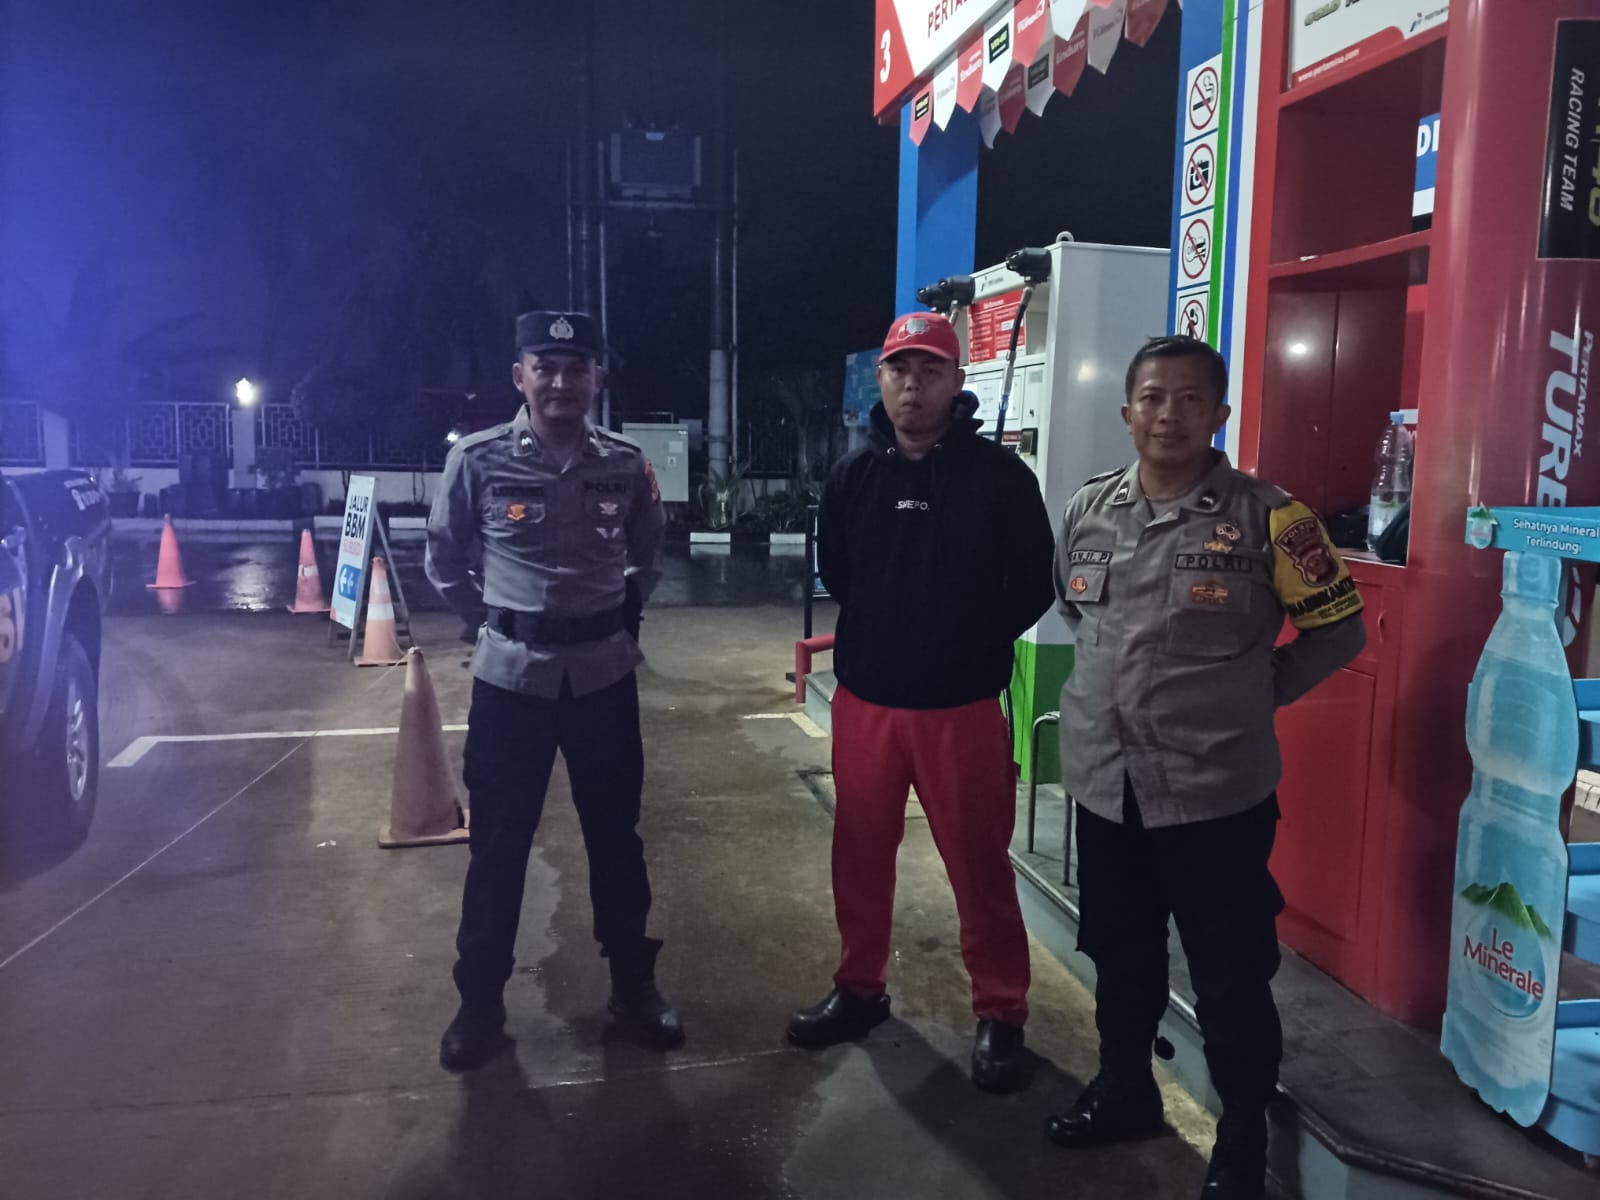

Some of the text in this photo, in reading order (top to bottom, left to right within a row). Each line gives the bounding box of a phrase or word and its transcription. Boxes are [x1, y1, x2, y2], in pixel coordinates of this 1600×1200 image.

[880, 28, 891, 83] 3
[1560, 67, 1585, 211] RACING TEAM
[1573, 329, 1594, 457] PERTAMAX
[349, 495, 369, 513] JALUR
[345, 511, 367, 540] BBM
[1513, 518, 1600, 538] Sehatnya Mineral
[1526, 535, 1582, 554] Terlindungi
[1186, 555, 1242, 569] POLRI
[1492, 927, 1514, 960] Le
[1464, 935, 1544, 1001] Minerale
